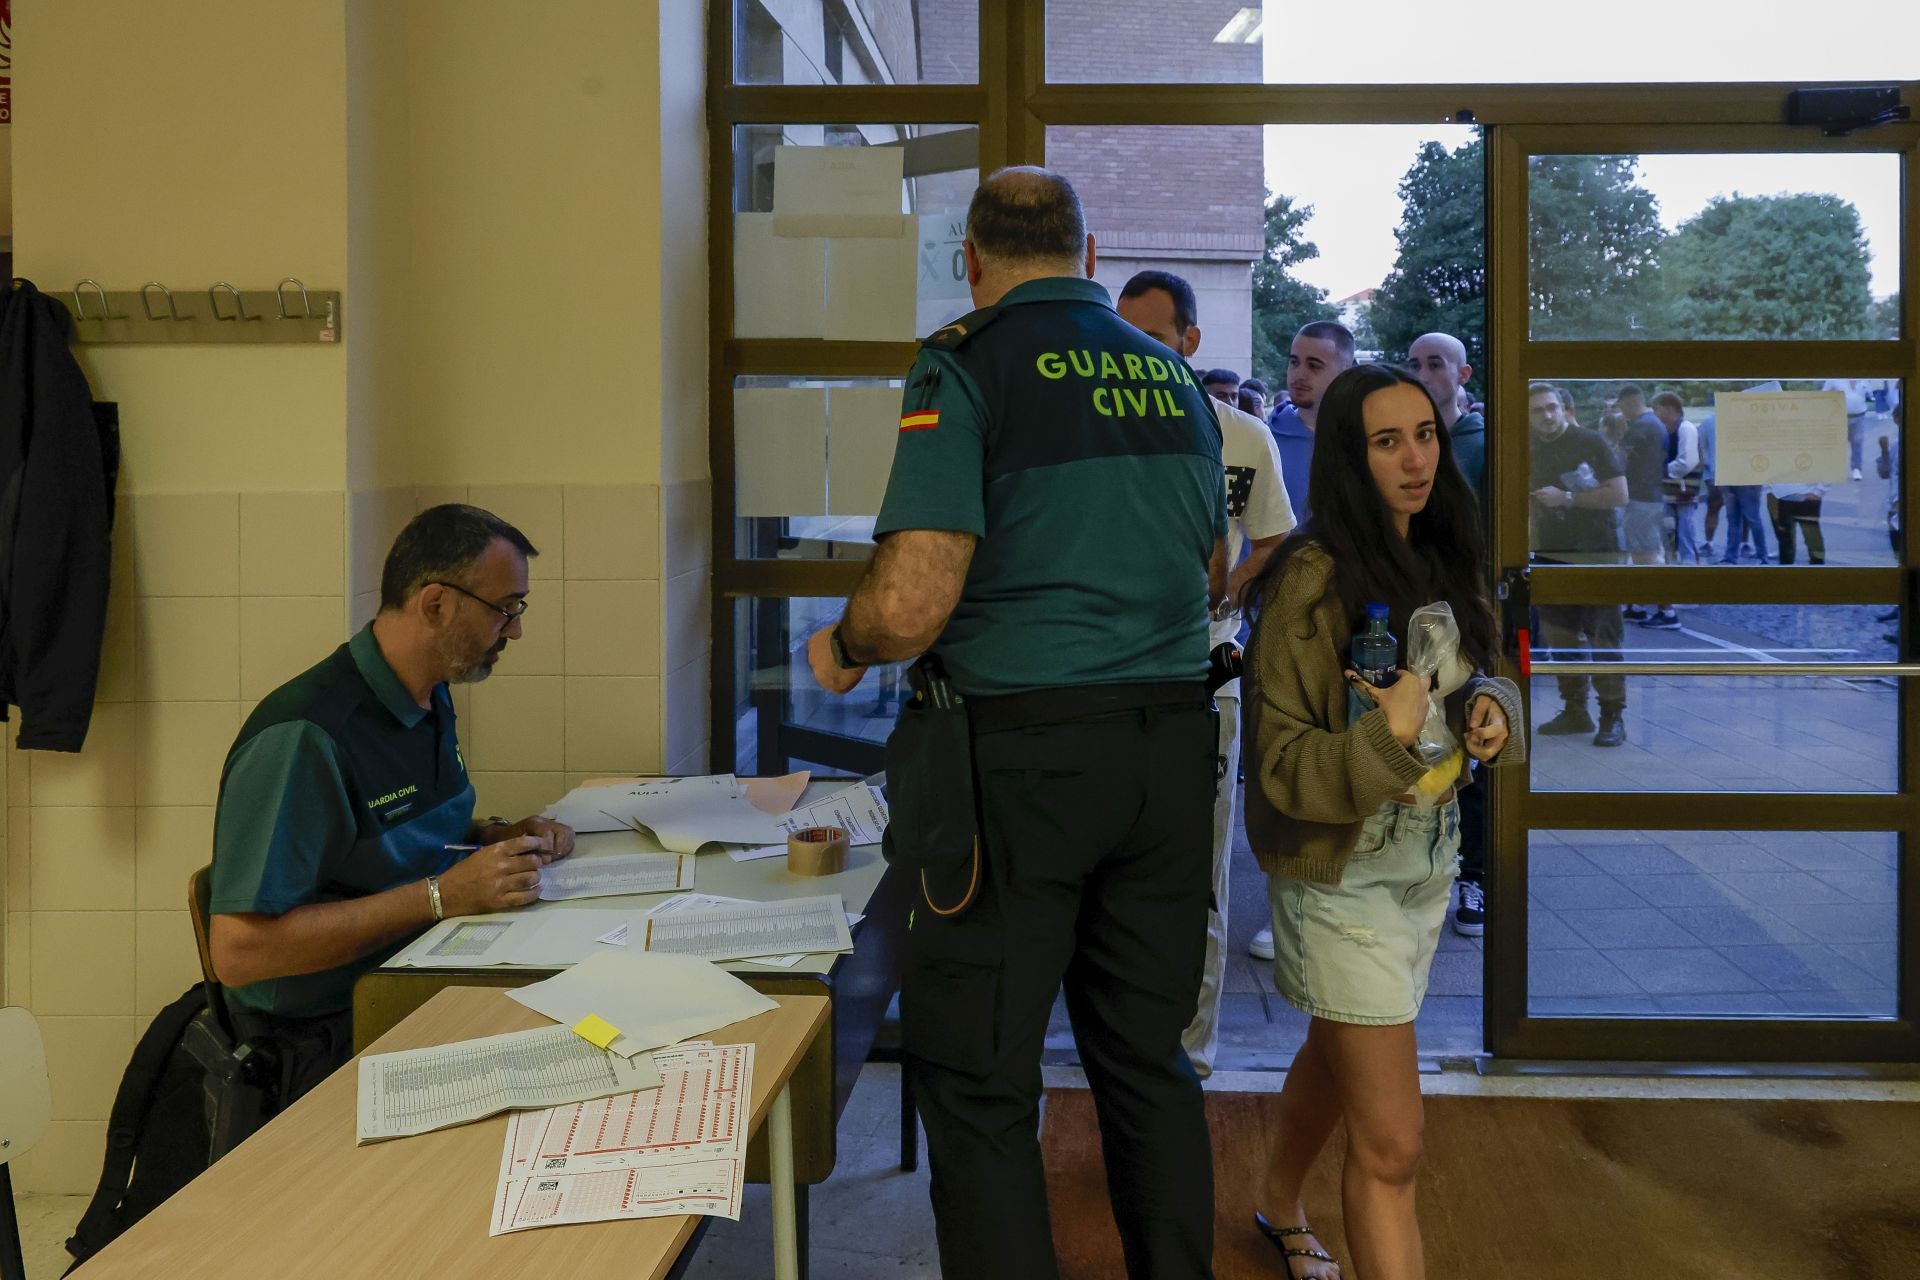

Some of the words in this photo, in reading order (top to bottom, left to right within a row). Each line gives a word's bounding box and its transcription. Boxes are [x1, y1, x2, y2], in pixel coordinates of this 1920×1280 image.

[1036, 350, 1198, 392] GUARDIA
[1092, 387, 1186, 417] CIVIL
[368, 793, 398, 809] UARDIA
[398, 785, 419, 797] CIVIL
